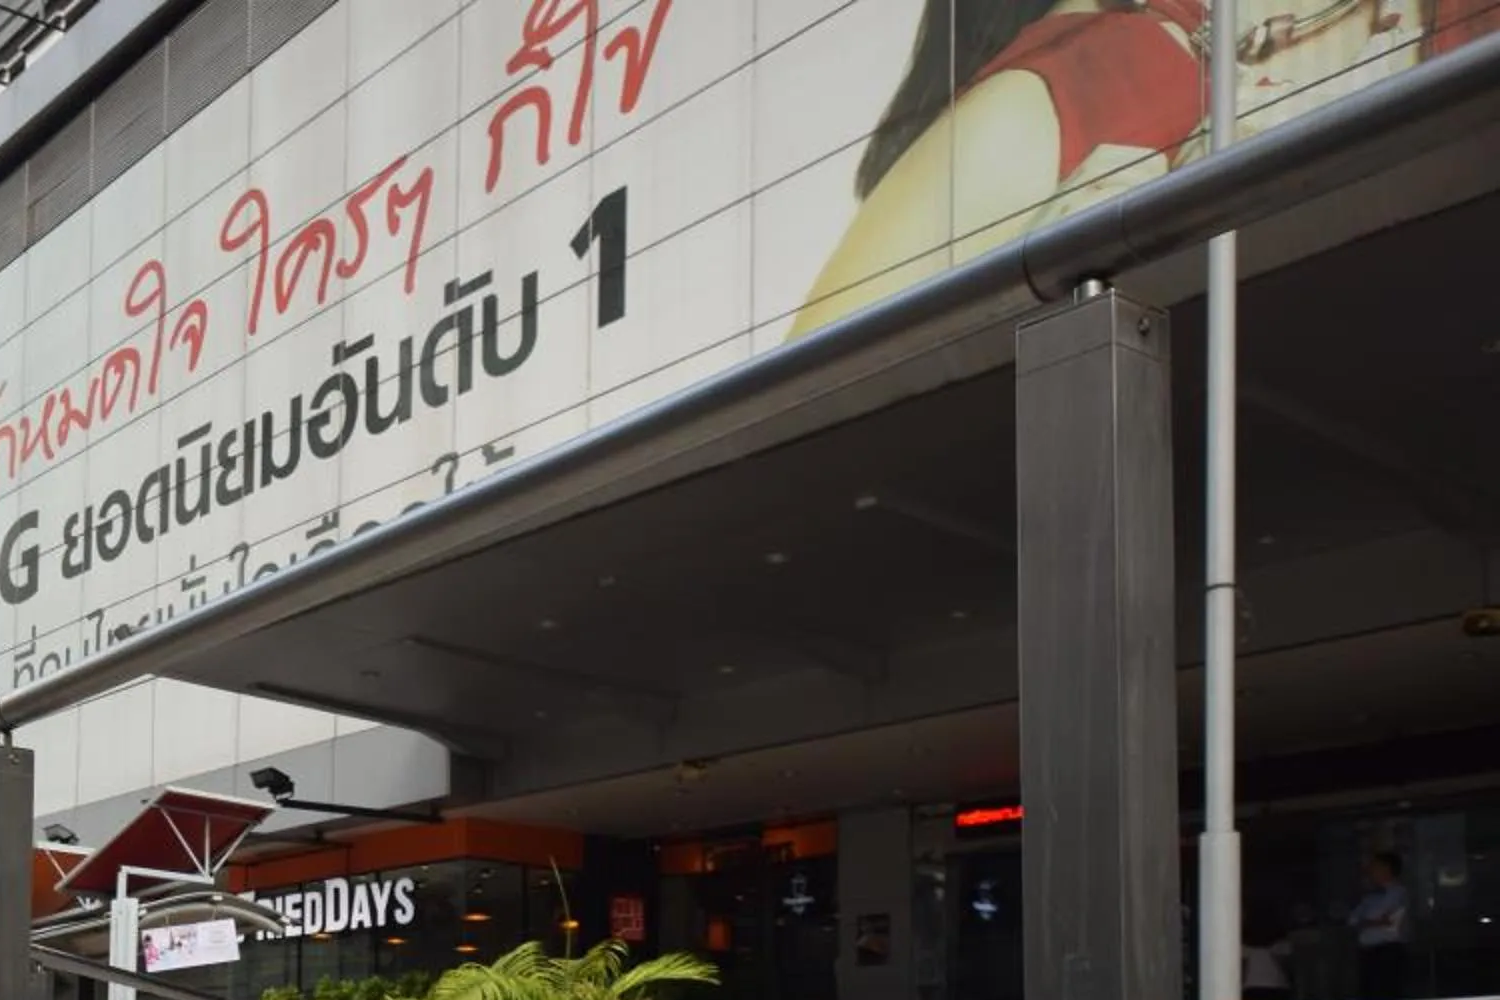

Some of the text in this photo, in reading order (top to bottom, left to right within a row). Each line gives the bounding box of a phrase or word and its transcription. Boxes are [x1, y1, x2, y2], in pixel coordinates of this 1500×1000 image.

[61, 268, 540, 580] ยอดนิยมอันดับ
[569, 186, 628, 329] 1
